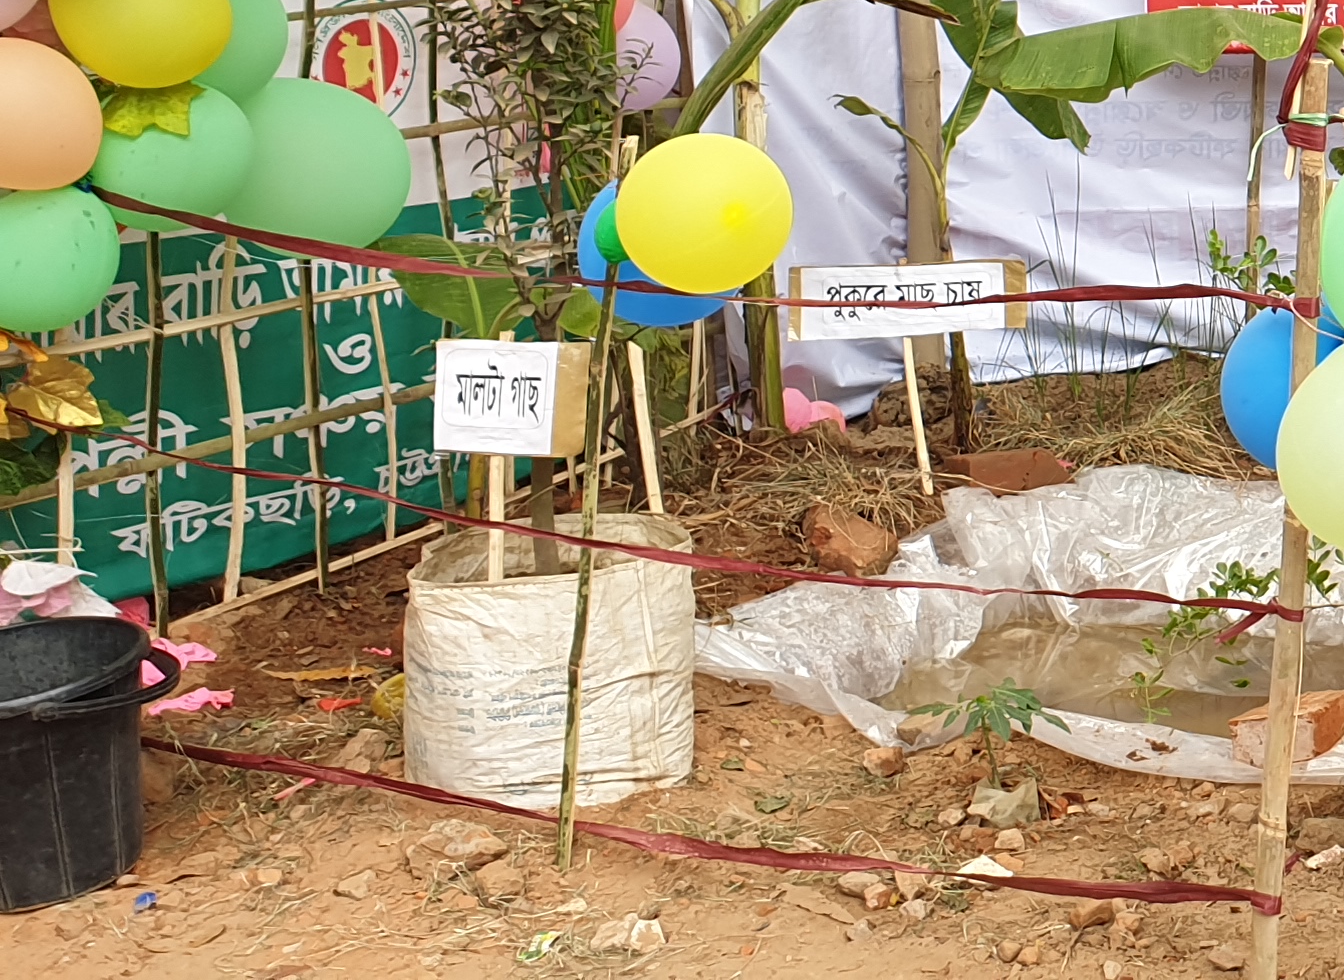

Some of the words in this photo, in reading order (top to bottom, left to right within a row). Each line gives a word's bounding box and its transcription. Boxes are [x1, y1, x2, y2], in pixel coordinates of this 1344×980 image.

[323, 333, 372, 374] ও
[455, 359, 505, 417] মালটা
[511, 372, 541, 423] গাছ
